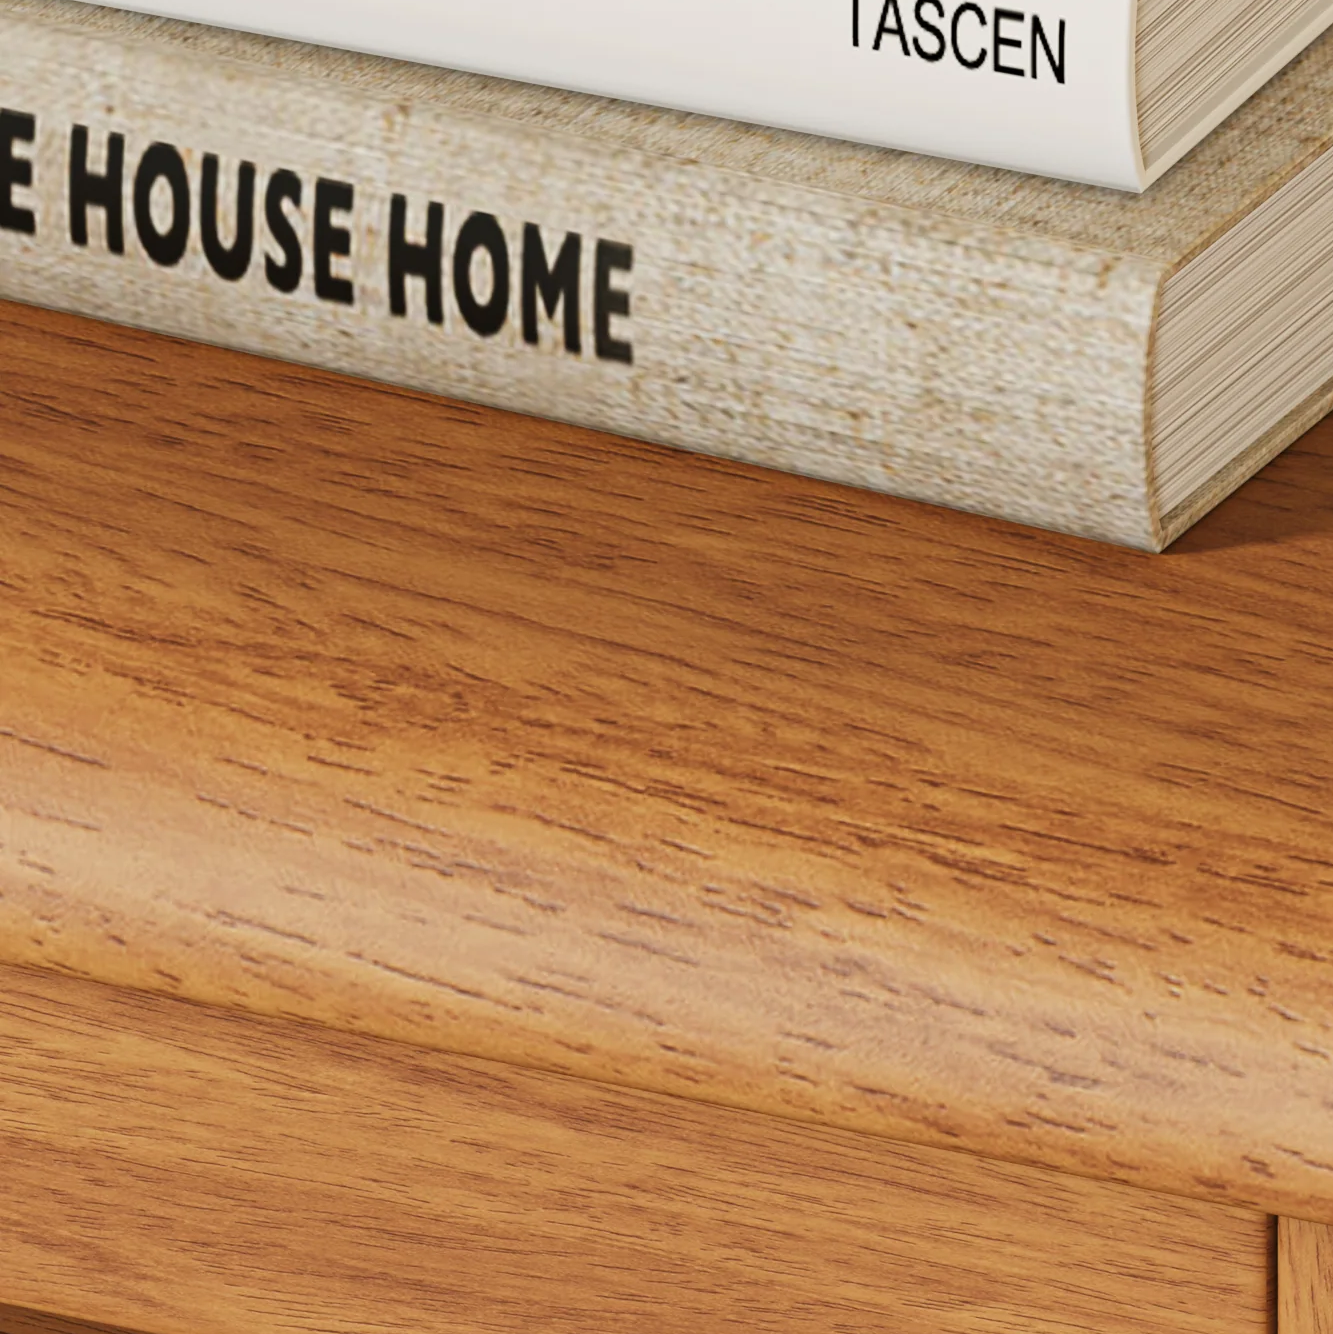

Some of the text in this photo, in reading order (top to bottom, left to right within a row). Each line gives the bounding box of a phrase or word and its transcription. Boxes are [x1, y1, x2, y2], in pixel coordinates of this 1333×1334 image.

[0, 108, 633, 366] E HOUSE HOME
